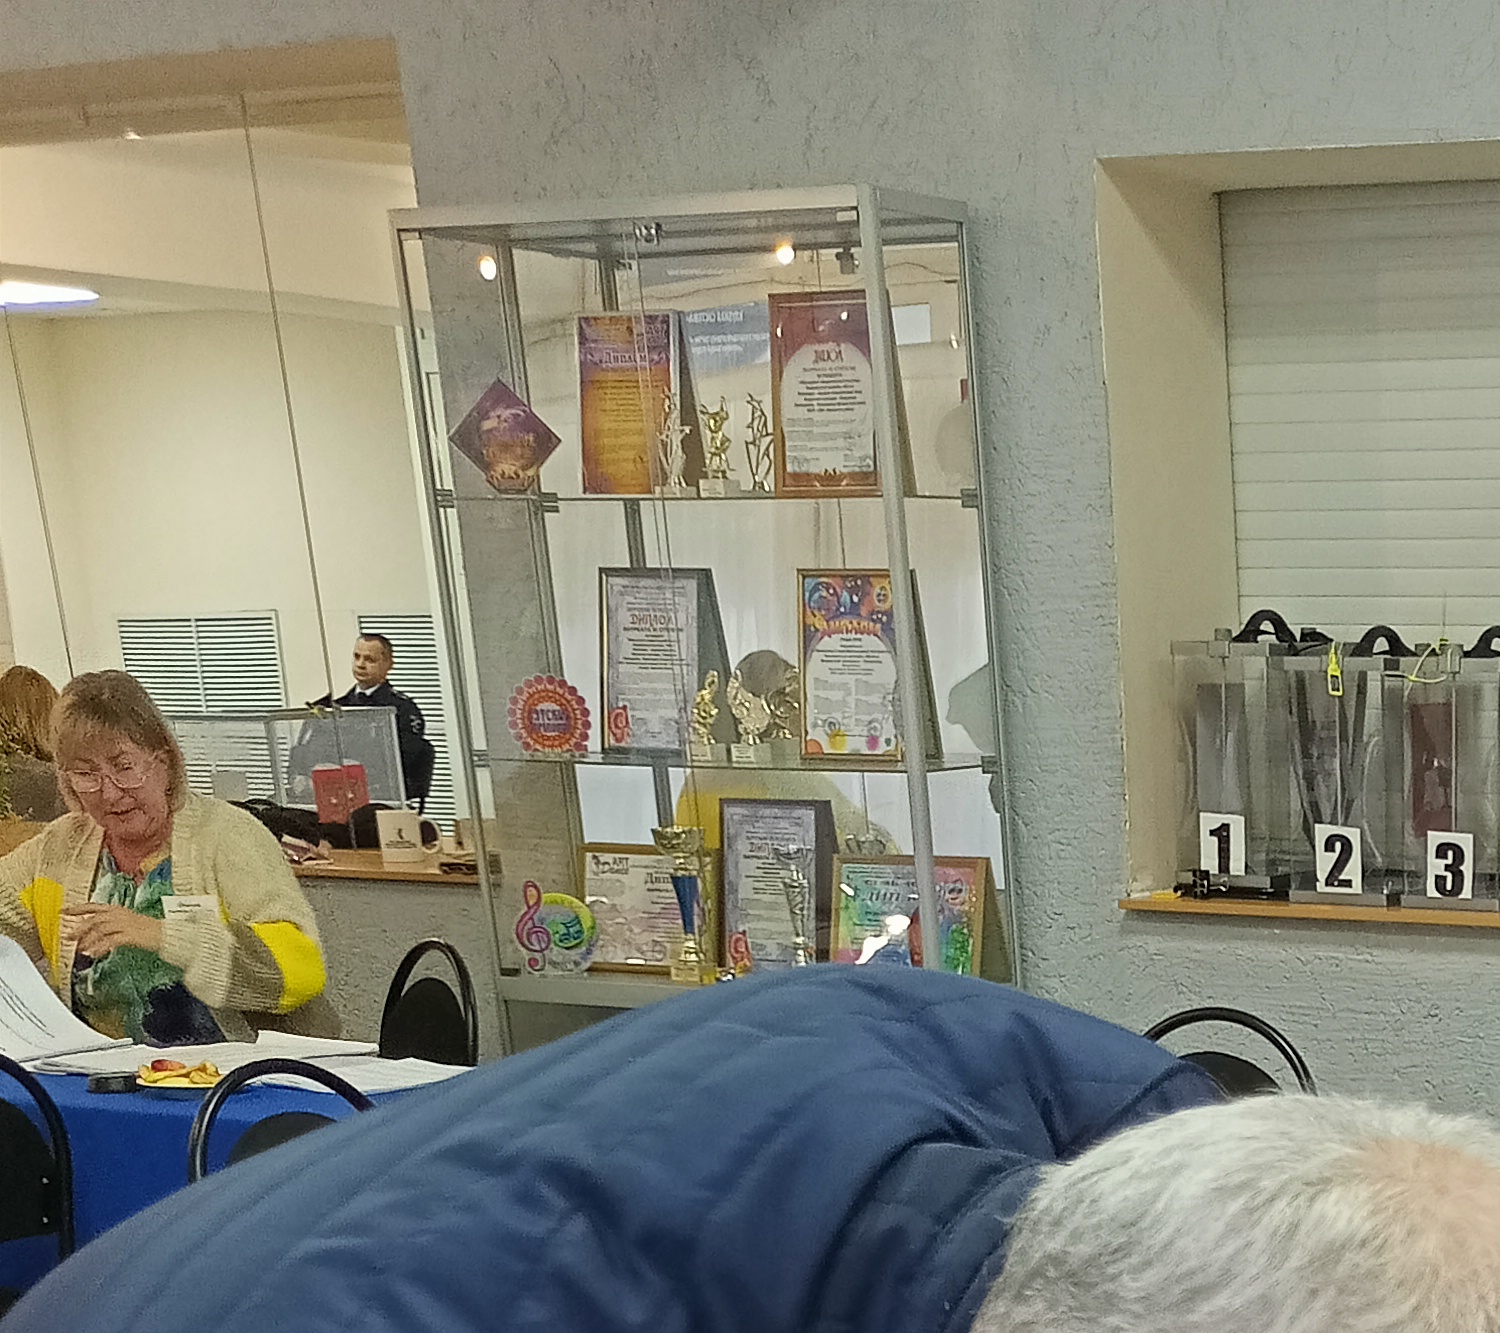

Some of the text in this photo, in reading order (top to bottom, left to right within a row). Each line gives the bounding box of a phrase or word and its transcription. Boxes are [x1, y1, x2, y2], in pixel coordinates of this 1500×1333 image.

[1207, 822, 1233, 875] 1
[1322, 833, 1354, 889] 2
[1433, 841, 1466, 898] 3
